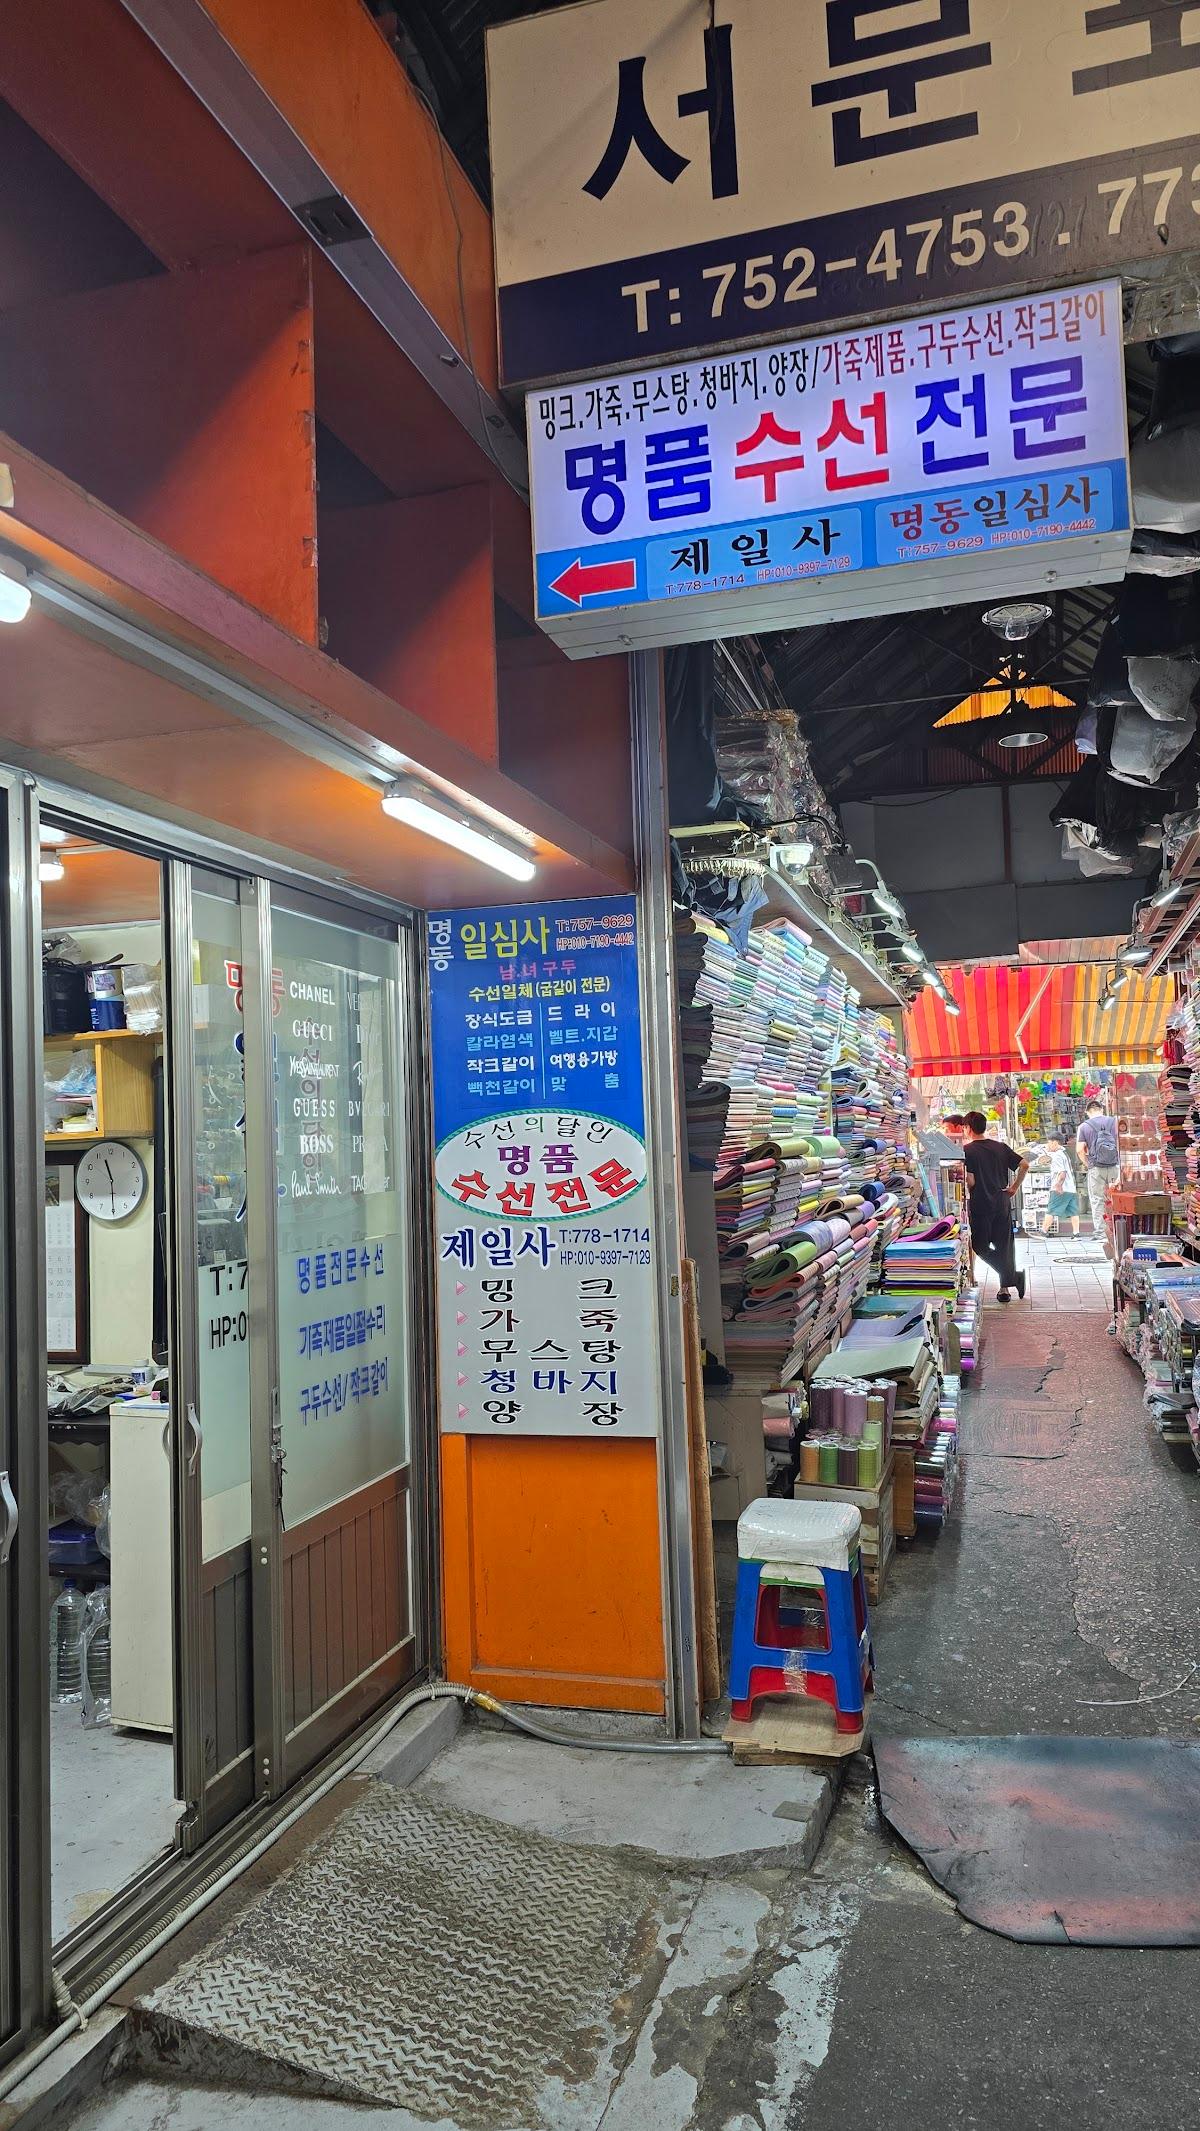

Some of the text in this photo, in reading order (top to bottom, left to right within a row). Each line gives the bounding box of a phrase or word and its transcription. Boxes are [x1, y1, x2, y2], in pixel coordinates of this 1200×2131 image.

[564, 355, 1088, 536] 명품 수선 전문
[555, 913, 635, 933] T:757-9629
[460, 916, 550, 961] 일심사
[289, 980, 336, 1006] CHANEL
[292, 1018, 333, 1042] GUCCI
[465, 1009, 533, 1030] 장식도금
[466, 1032, 534, 1052] 칼라염색
[467, 1055, 535, 1074] 작크갈이
[549, 1050, 618, 1070] 여행용가방
[293, 1098, 336, 1118] GUESS
[300, 1134, 335, 1155] BOSS
[497, 1143, 579, 1176] 명품
[291, 1170, 342, 1198] Paul Smith
[442, 1226, 557, 1268] 제일사
[559, 1228, 650, 1245] T:778-1714
[560, 1249, 651, 1266] HP:010-9397-7129
